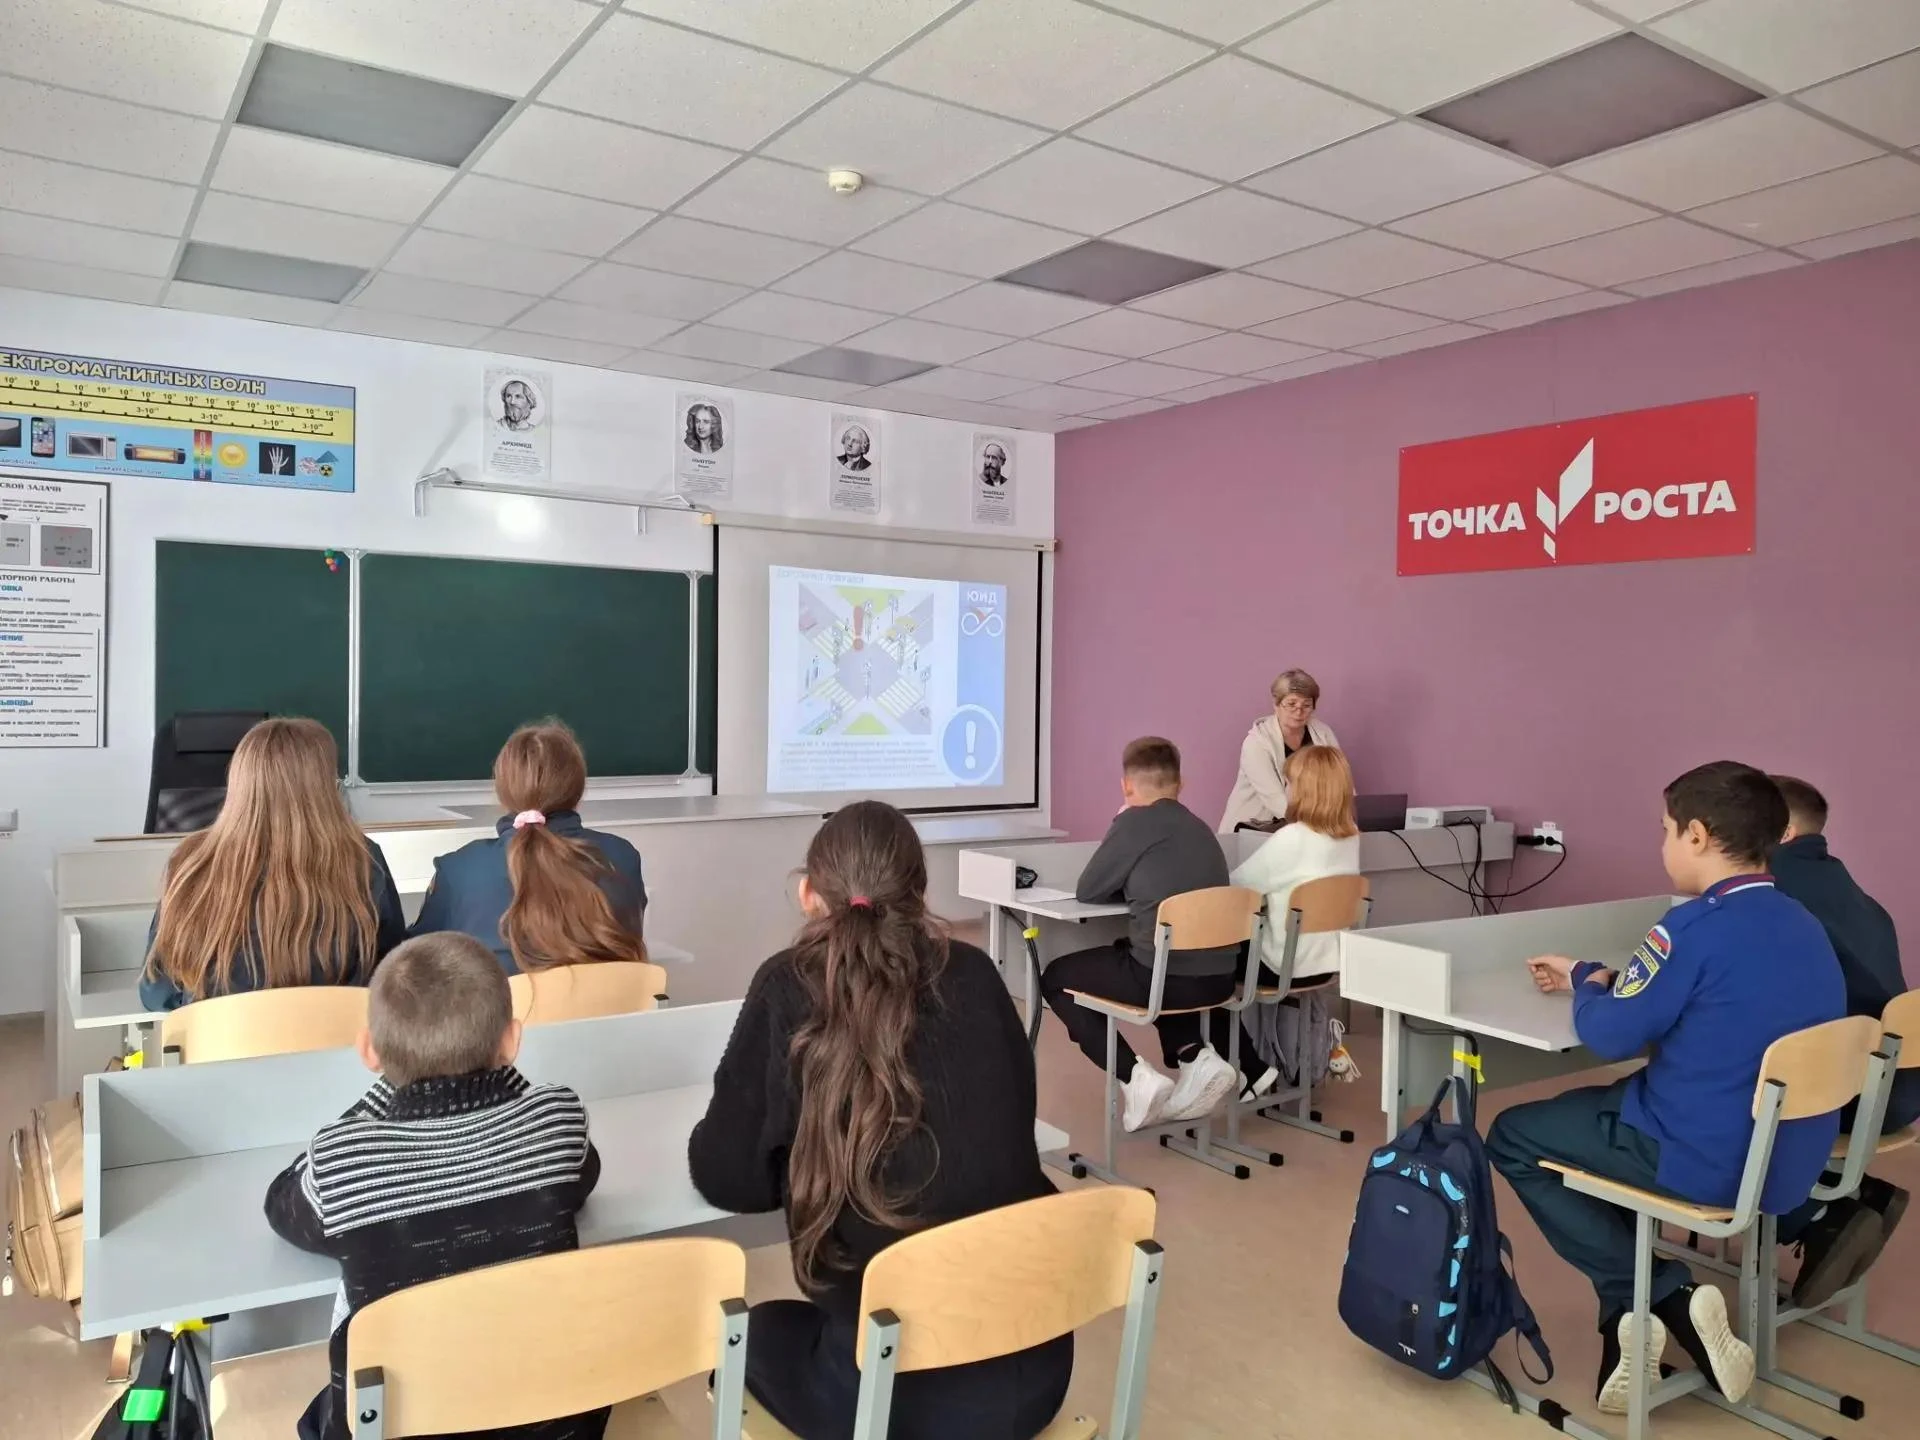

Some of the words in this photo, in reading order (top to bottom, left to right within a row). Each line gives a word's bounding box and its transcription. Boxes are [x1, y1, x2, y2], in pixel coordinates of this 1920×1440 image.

[0, 352, 206, 389] ЕКТРОМАГНИТНЫХ
[209, 376, 266, 395] ВОЛН
[30, 379, 40, 387] 10
[28, 484, 61, 492] ЗАДАЧИ
[1408, 502, 1526, 540] ТОЧКА
[1594, 480, 1737, 524] РОСТА
[40, 576, 75, 584] РАБОТЫ
[0, 584, 23, 592] ОВКА
[968, 590, 998, 605] ЮИД
[0, 699, 33, 707] ЫВОДЫ
